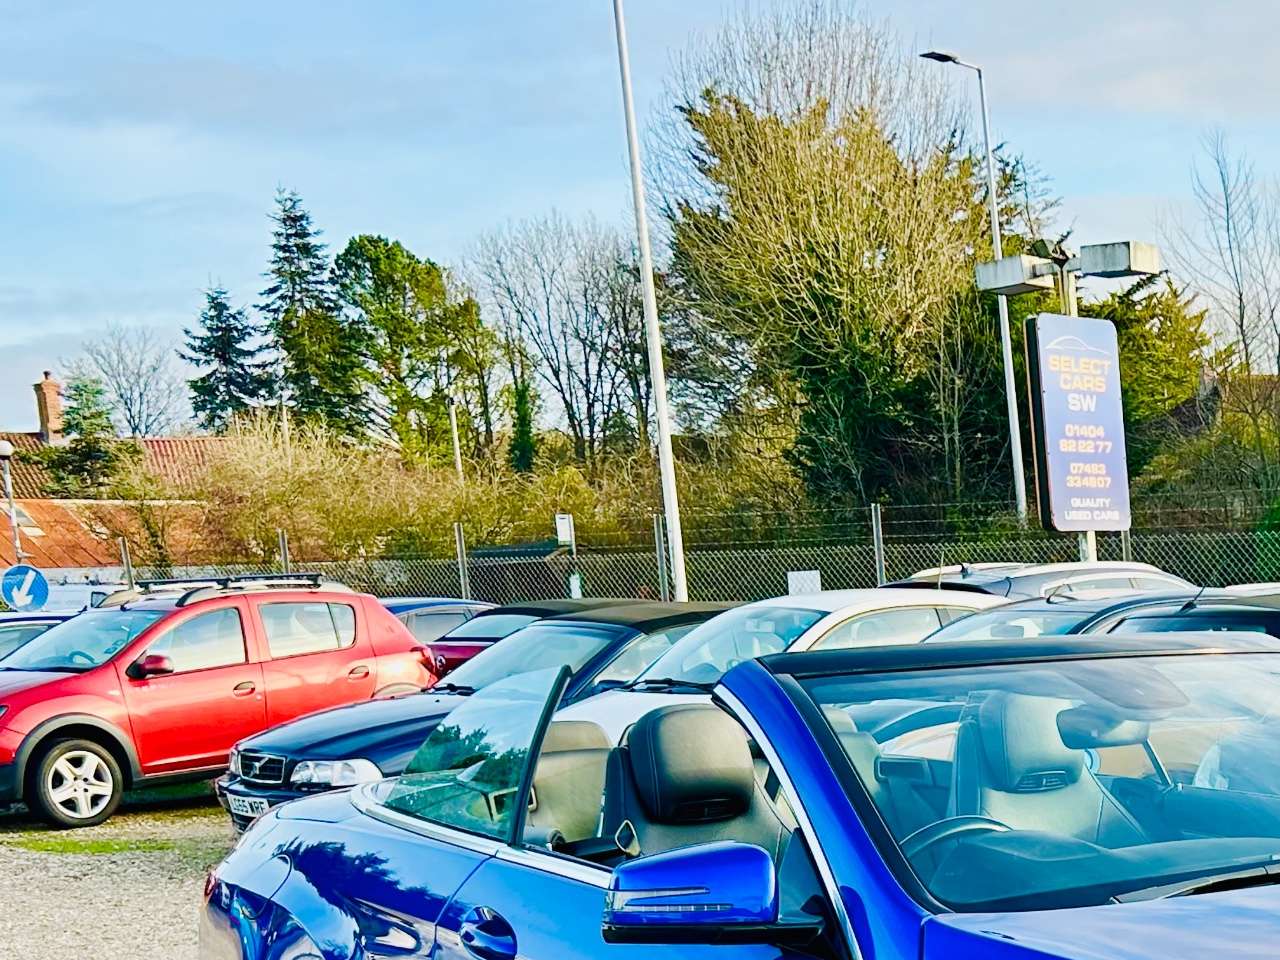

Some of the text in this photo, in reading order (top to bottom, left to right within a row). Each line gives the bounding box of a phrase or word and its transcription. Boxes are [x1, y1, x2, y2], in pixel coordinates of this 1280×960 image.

[1049, 355, 1111, 375] SELECT
[1060, 373, 1106, 393] CARS
[1067, 393, 1097, 412] SW
[1064, 423, 1104, 438] 01404
[1059, 438, 1112, 454] 82 22 77
[1070, 497, 1111, 508] QUALITY
[1064, 510, 1120, 521] USED CARS
